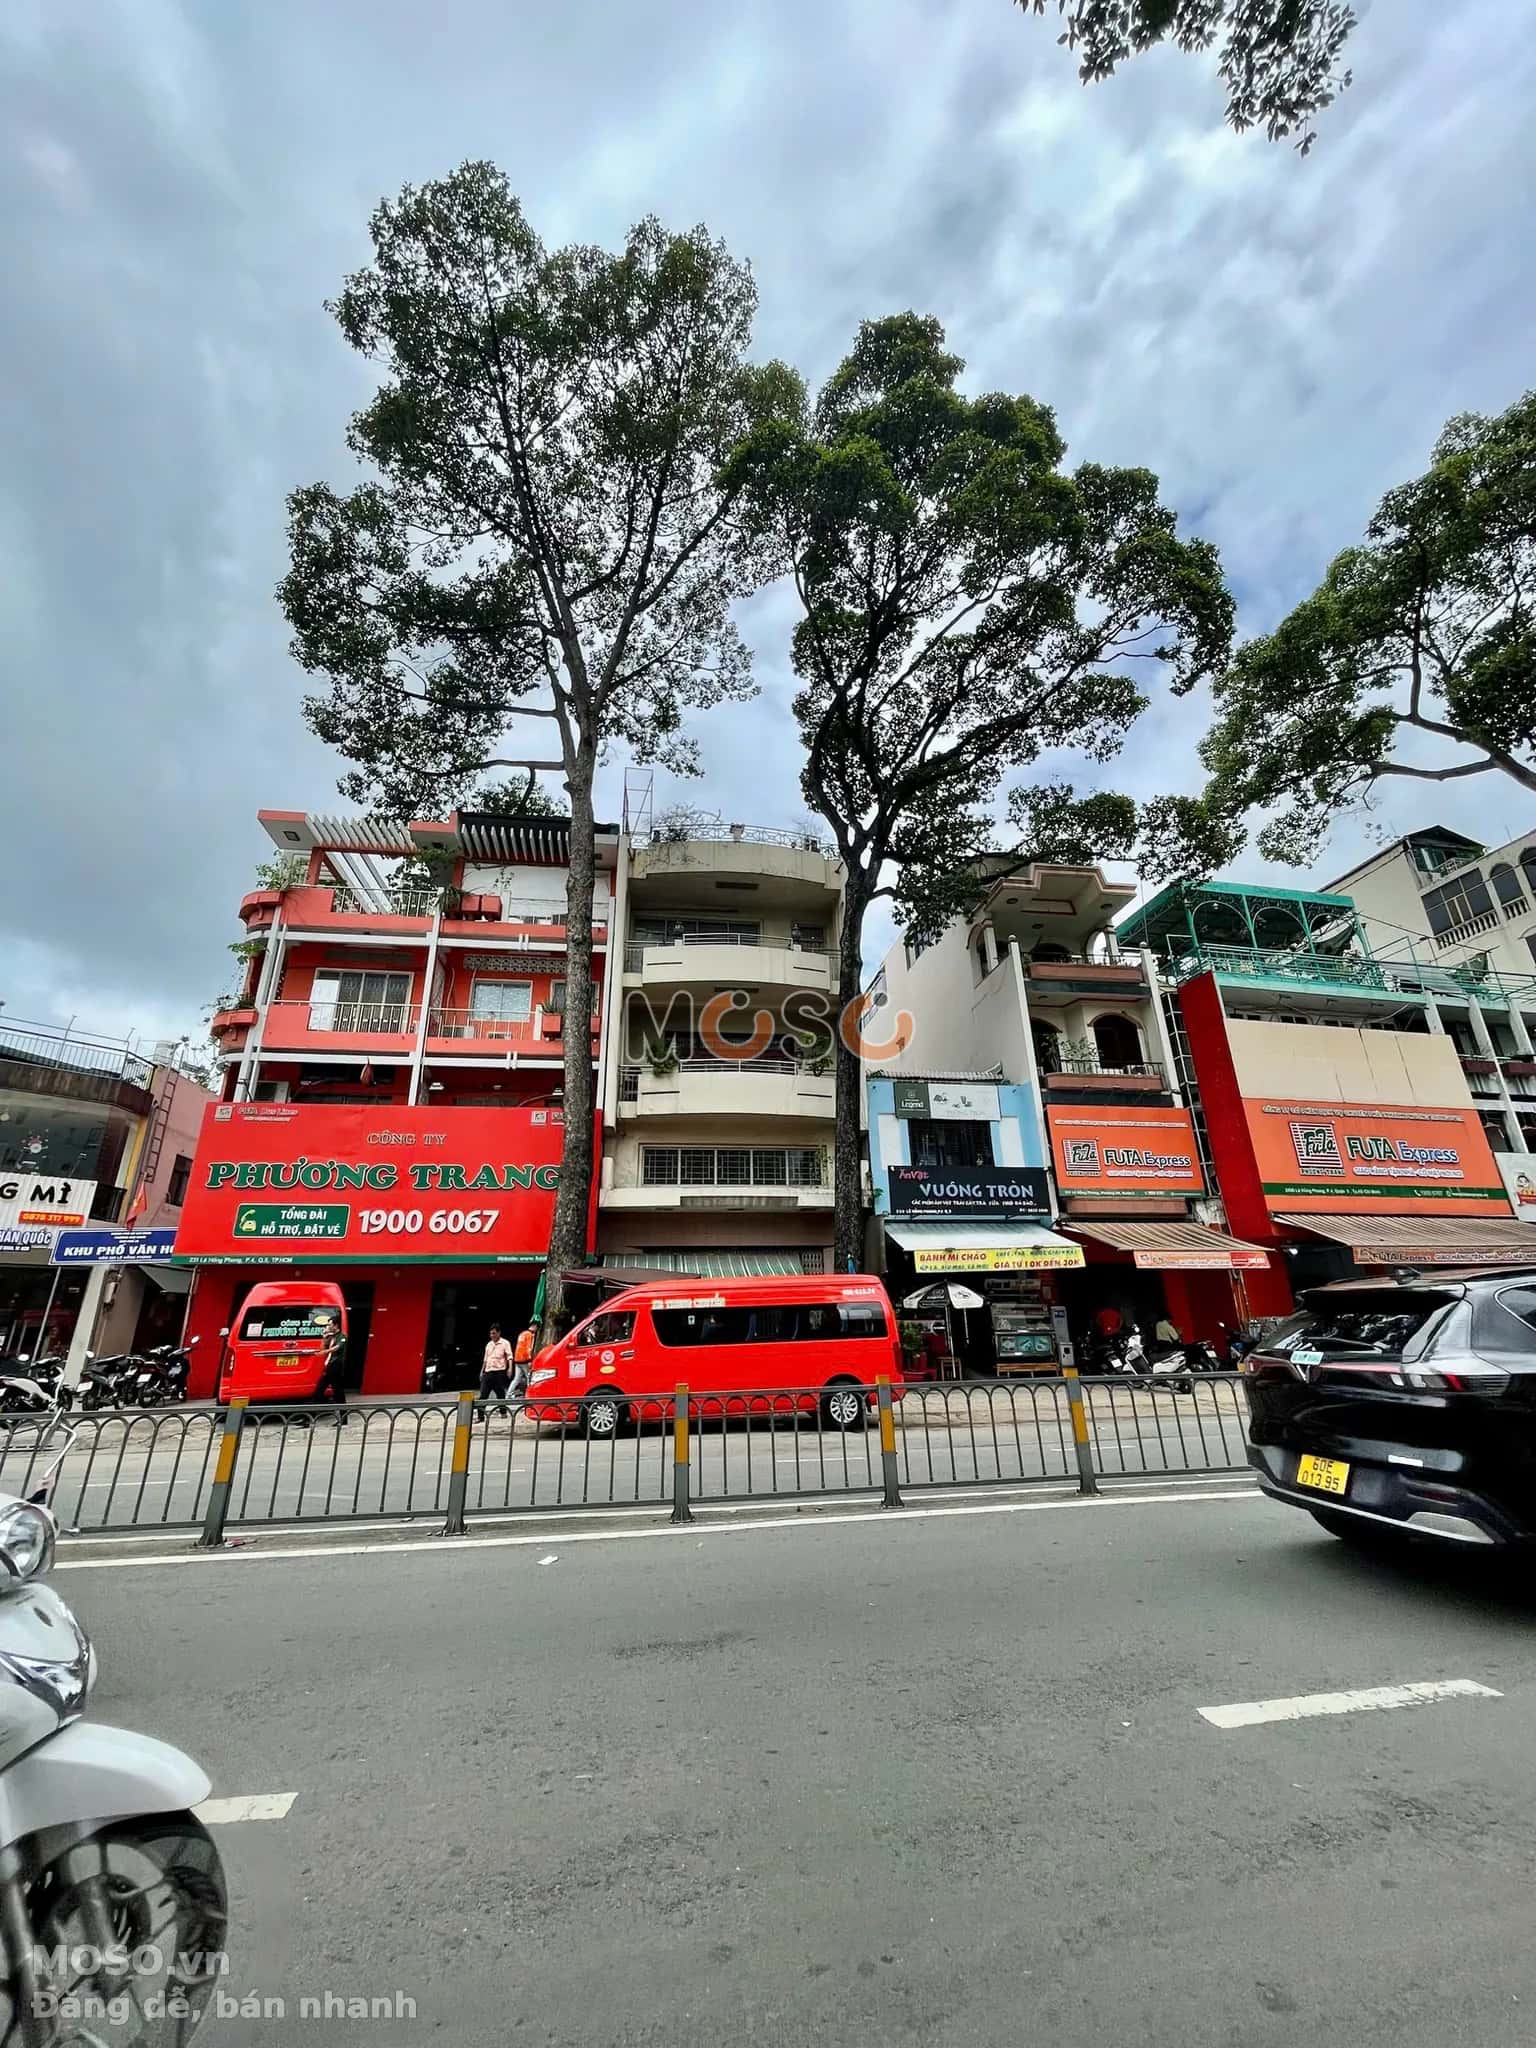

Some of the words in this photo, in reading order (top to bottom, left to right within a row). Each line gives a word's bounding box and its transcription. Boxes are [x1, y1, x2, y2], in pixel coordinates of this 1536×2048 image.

[367, 1129, 417, 1145] CÔNG
[424, 1133, 447, 1145] TY
[1103, 1148, 1144, 1165] FUTA
[1144, 1152, 1191, 1168] Express
[1345, 1136, 1399, 1161] FUTA
[1396, 1140, 1460, 1166] Express
[206, 1157, 399, 1190] PHƯƠNG
[408, 1163, 560, 1190] TRANG
[985, 1180, 1034, 1198] TRÒN
[281, 1205, 308, 1220] TỔNG
[309, 1208, 327, 1220] ĐÀI
[358, 1209, 424, 1234] 1900
[428, 1209, 501, 1234] 6067
[260, 1221, 276, 1234] HỖ
[279, 1222, 302, 1236] TRỢ,
[304, 1223, 325, 1237] ĐẶT
[327, 1222, 341, 1235] VÉ
[63, 1246, 94, 1256] KHU
[95, 1242, 126, 1256] PHỐ
[128, 1243, 157, 1255] VĂN
